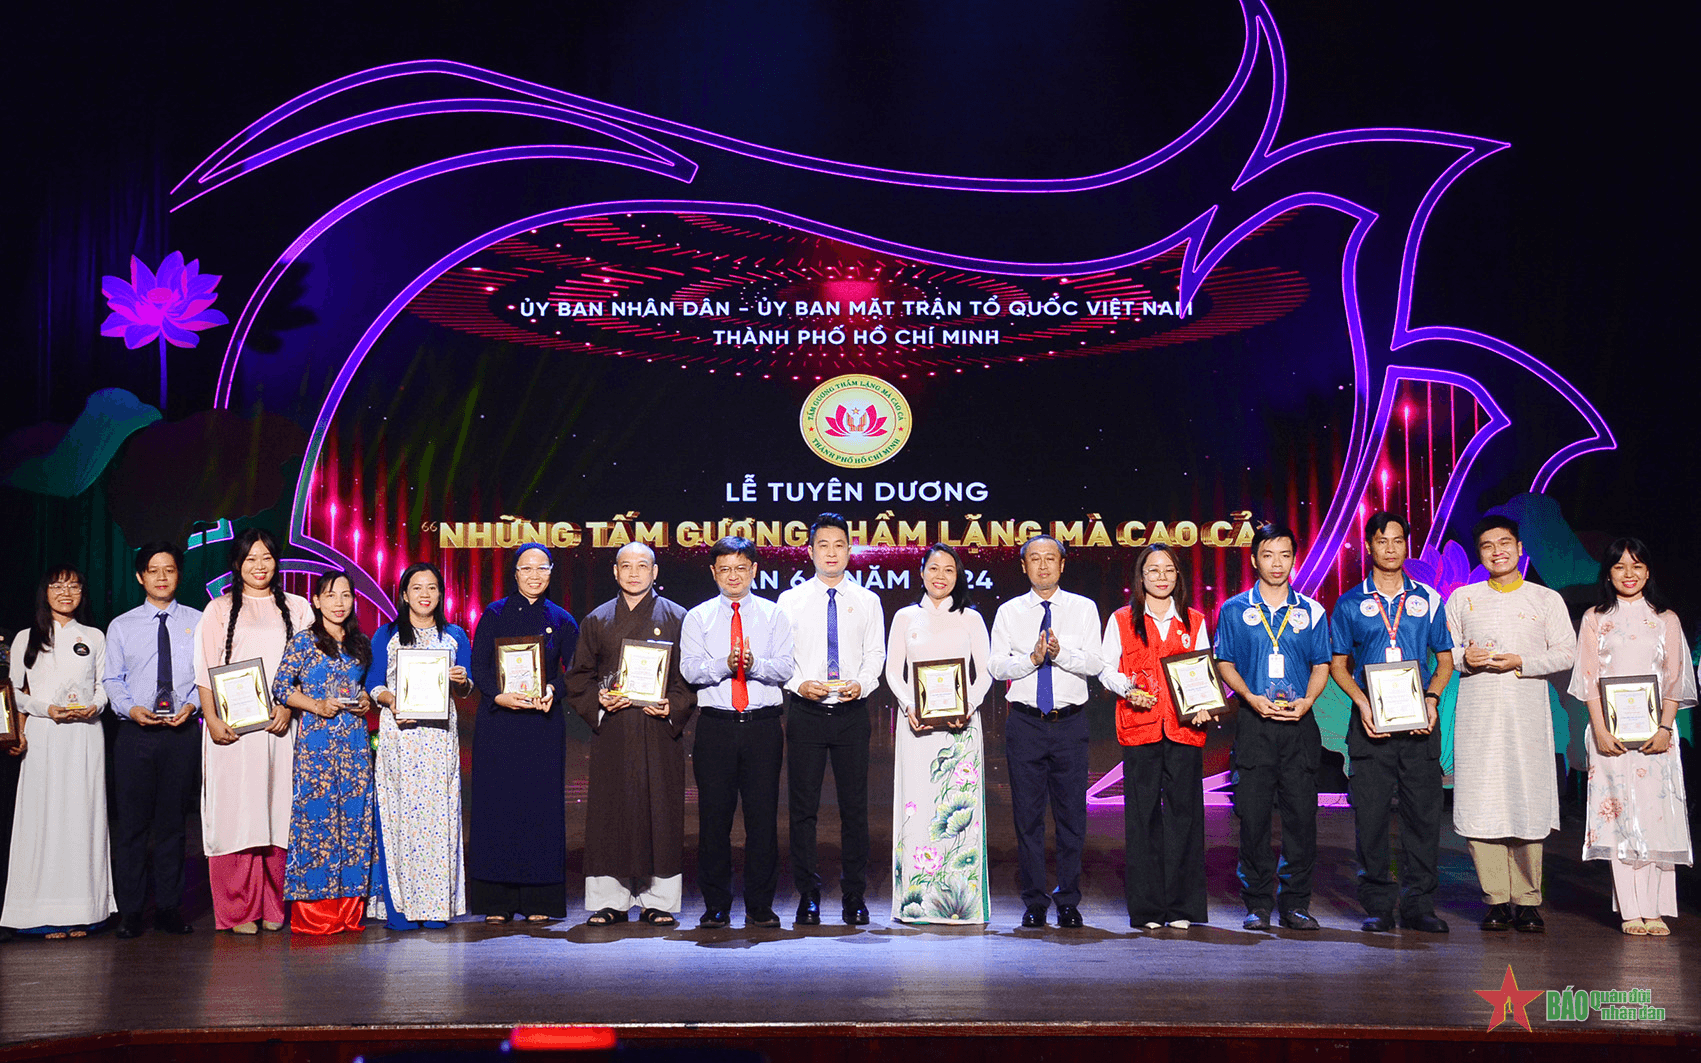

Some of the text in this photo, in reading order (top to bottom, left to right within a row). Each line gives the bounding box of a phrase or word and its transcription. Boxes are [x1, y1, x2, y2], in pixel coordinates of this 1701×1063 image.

[520, 297, 550, 317] ỦY
[557, 301, 603, 317] BAN
[611, 297, 675, 317] NHÂN
[682, 297, 730, 317] DÂN
[757, 297, 788, 317] ỦY
[795, 301, 840, 317] BAN
[849, 297, 896, 320] MẶT
[902, 297, 961, 320] TRẬN
[969, 295, 1001, 316] TỔ
[1008, 295, 1078, 317] QUỐC
[1087, 297, 1135, 320] VIỆT
[1142, 300, 1193, 316] NAM
[712, 325, 999, 345] THÀNH PHỐ HỒ CHÍ MINH
[726, 473, 989, 502] LỄ TUYÊN DƯƠNG
[585, 511, 669, 548] TẤM
[676, 517, 809, 548] GƯƠNG
[846, 510, 927, 547] HẦM
[938, 513, 1042, 554] LẶNG
[1050, 513, 1113, 547] MÀ
[1116, 520, 1198, 547] CAO
[844, 565, 910, 589] NĂM
